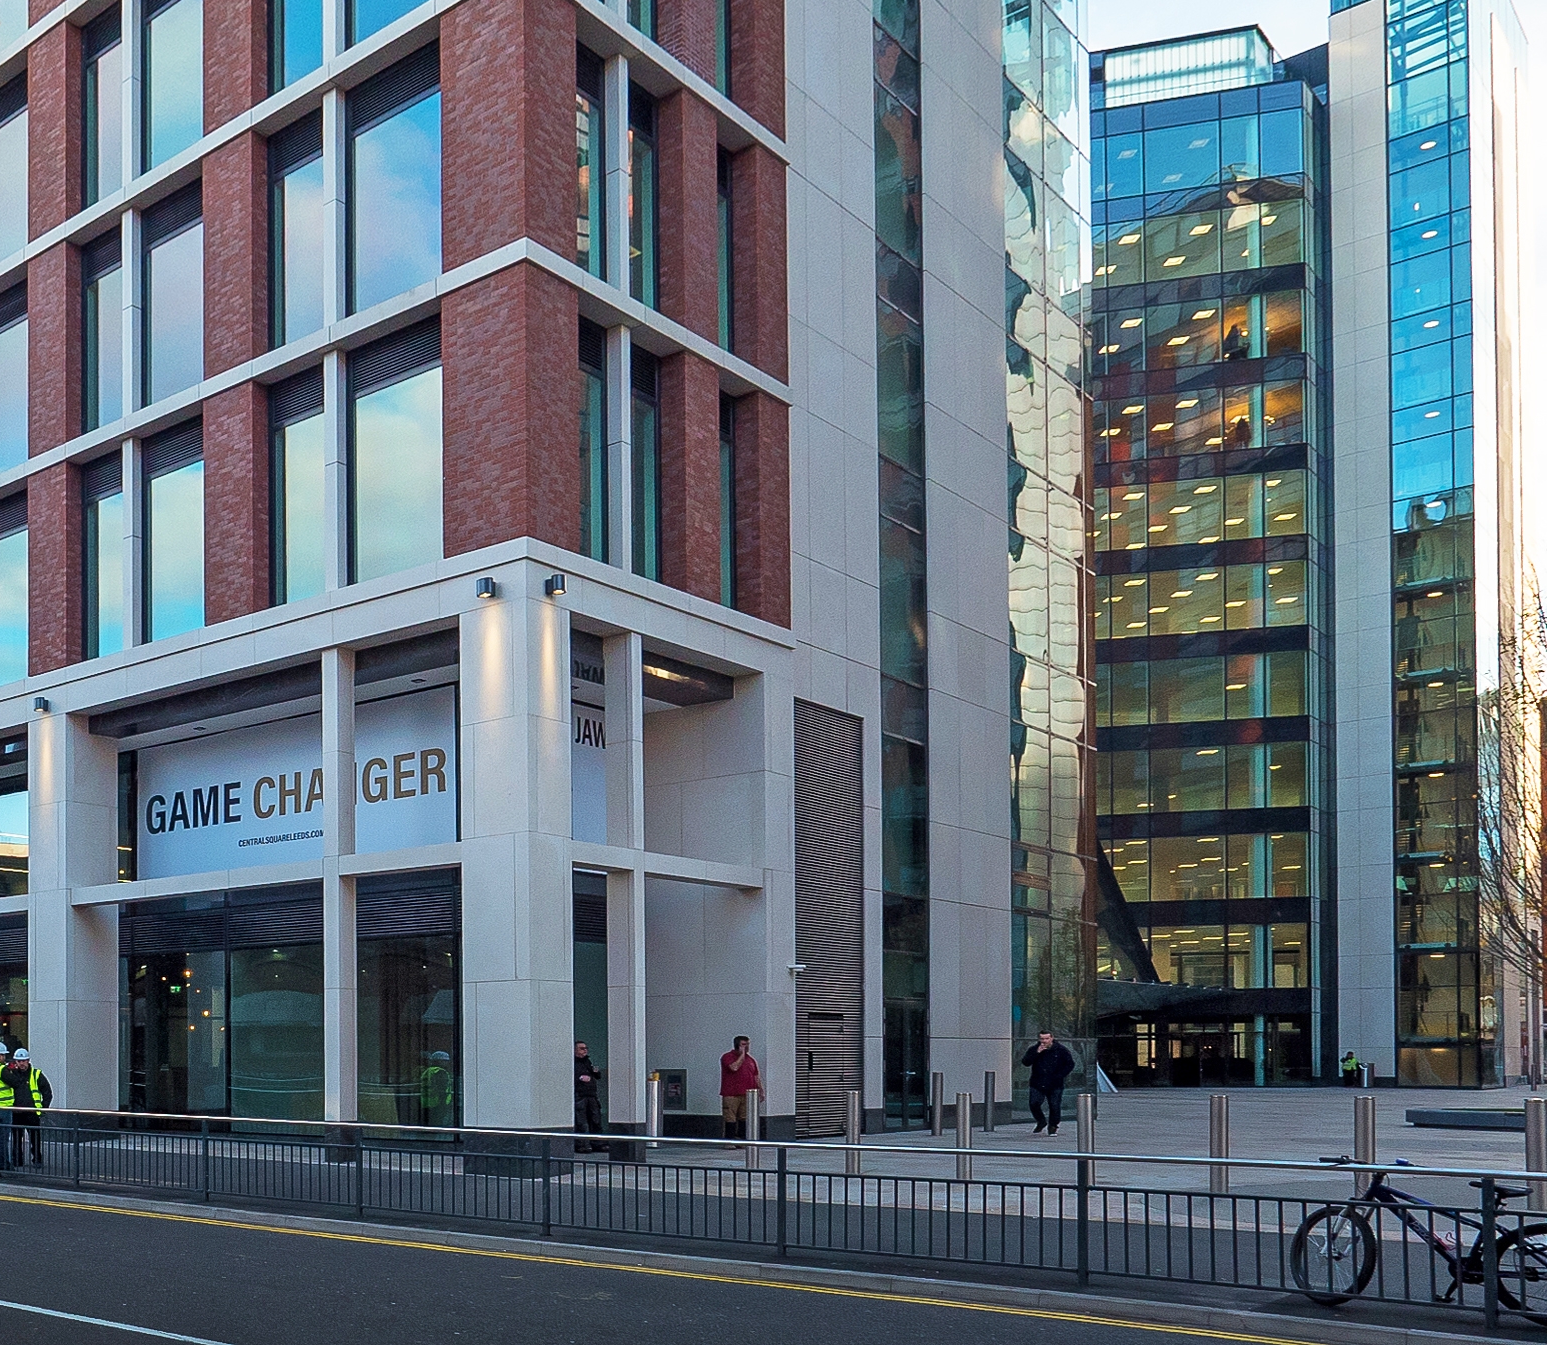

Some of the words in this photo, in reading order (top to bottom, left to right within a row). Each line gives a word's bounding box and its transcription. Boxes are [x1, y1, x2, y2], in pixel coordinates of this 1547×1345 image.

[575, 716, 606, 749] JAW
[145, 781, 241, 835] GAME
[253, 747, 447, 819] CHAGER
